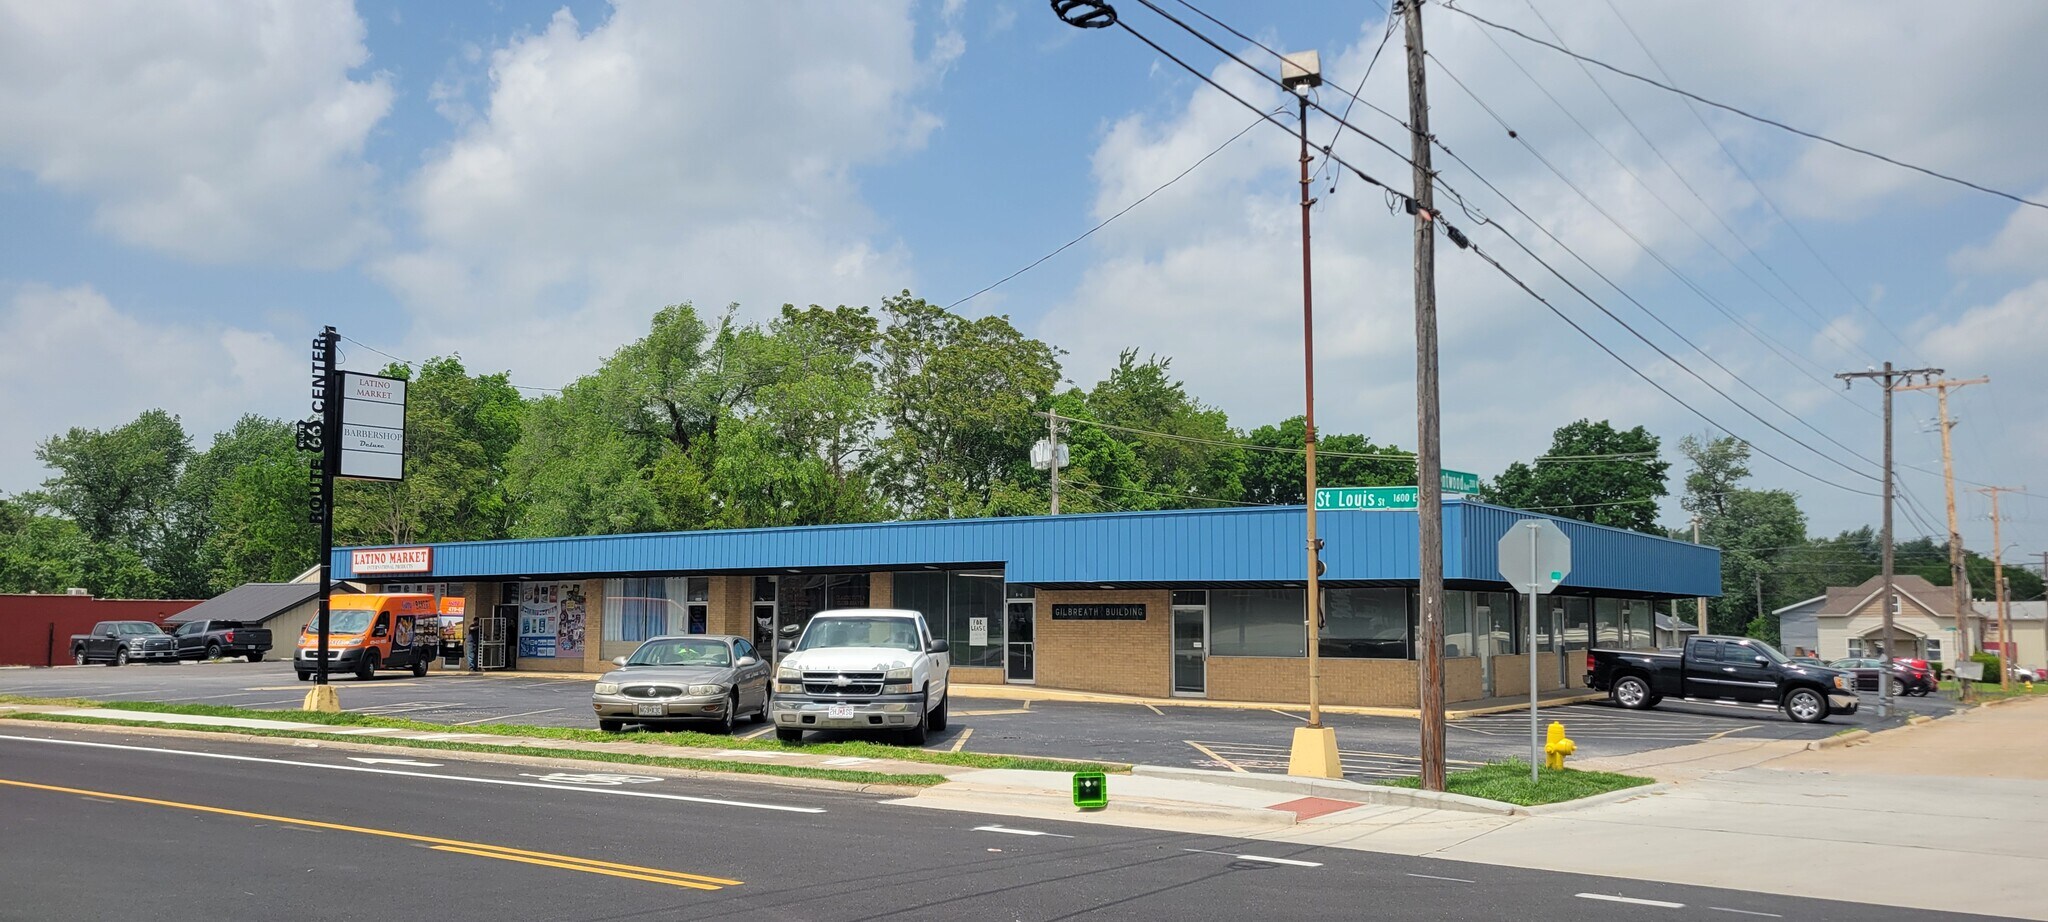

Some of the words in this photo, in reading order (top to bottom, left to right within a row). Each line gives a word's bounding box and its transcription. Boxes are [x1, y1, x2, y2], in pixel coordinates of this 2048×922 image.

[312, 337, 326, 414] CENTER
[359, 379, 391, 389] LATINO
[356, 389, 393, 399] MARKET
[307, 425, 322, 448] 66
[344, 428, 403, 441] BARBERSHOP
[359, 440, 385, 448] Deluxe
[309, 459, 325, 523] ROUTE
[1317, 491, 1331, 507] St
[1338, 490, 1375, 507] Louis
[1377, 498, 1385, 506] St
[1393, 493, 1410, 502] 1600
[1412, 493, 1417, 502] E
[355, 553, 386, 565] LATINO
[390, 551, 426, 564] MARKET
[1055, 607, 1099, 617] GILBREATH
[1105, 607, 1143, 616] BUILDING
